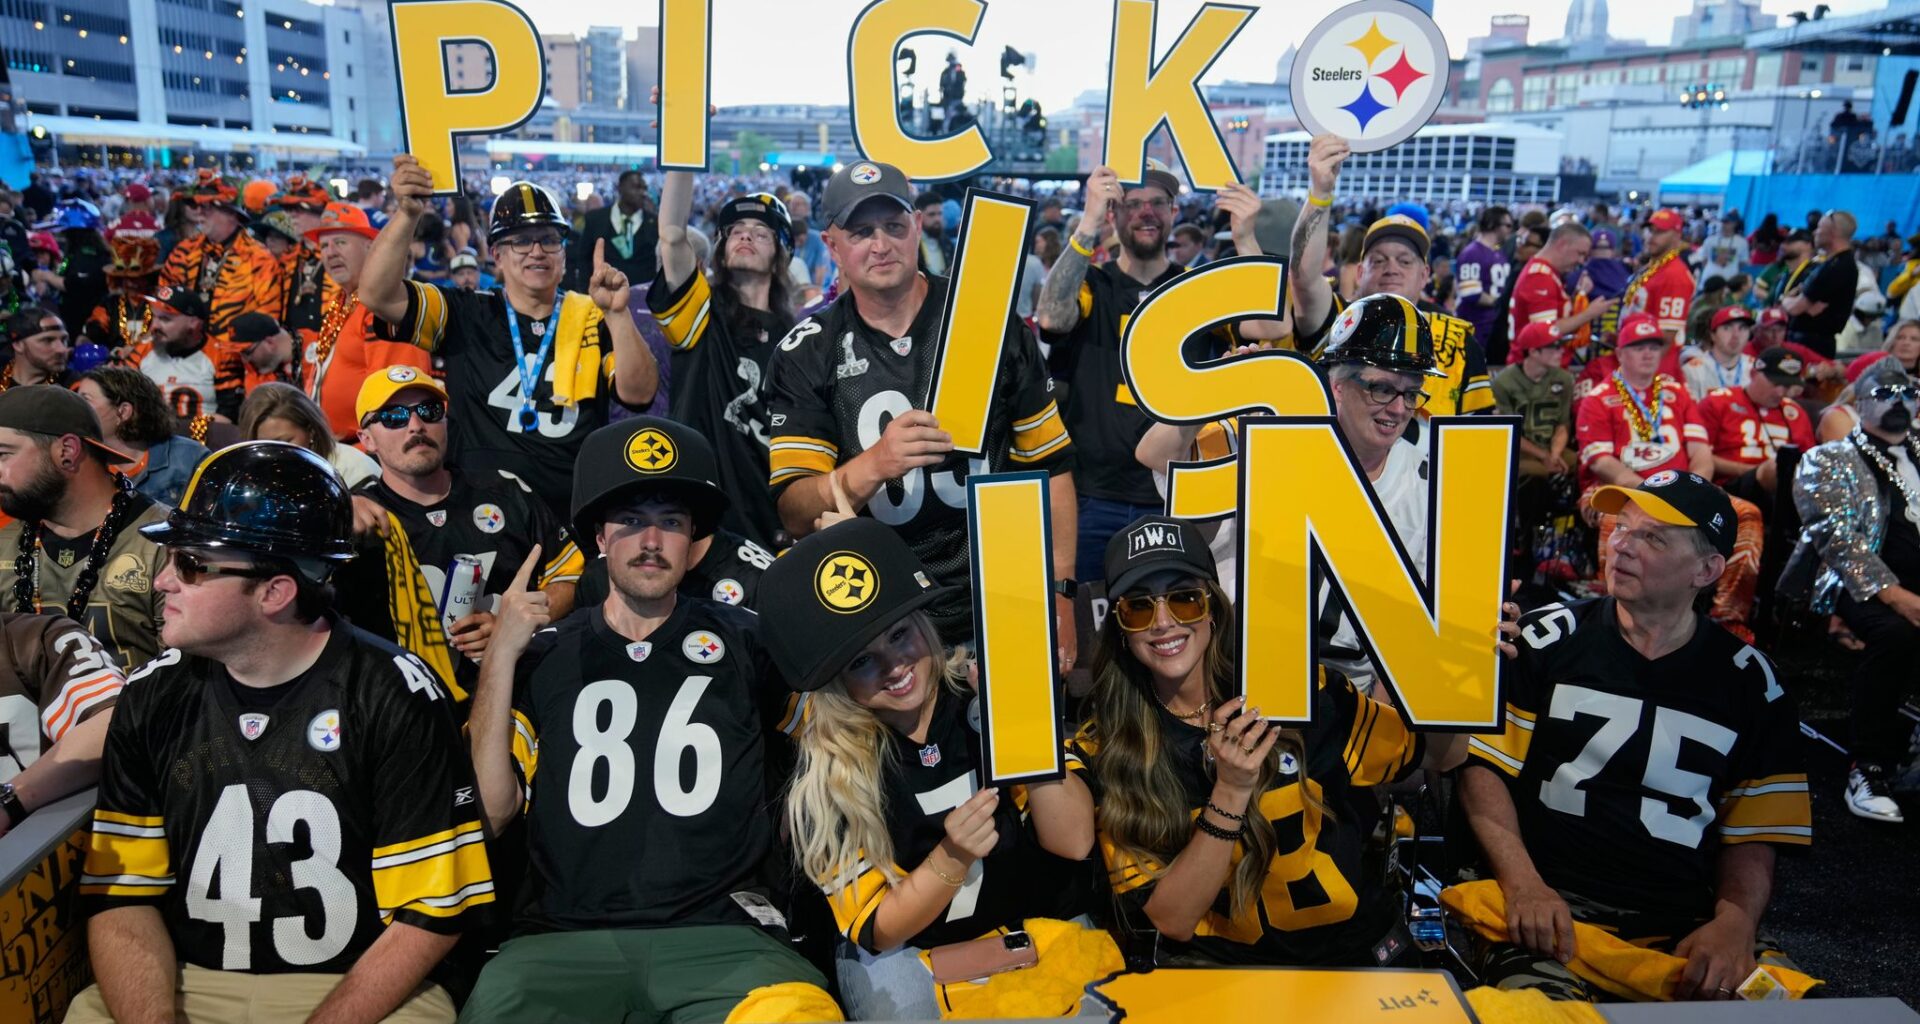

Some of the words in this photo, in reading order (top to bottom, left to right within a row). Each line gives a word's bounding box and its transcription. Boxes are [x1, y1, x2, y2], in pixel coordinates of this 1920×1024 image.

[1312, 67, 1362, 81] Steelers
[1460, 263, 1480, 280] 80
[1659, 297, 1684, 318] 58
[1135, 527, 1176, 550] nWo
[826, 581, 847, 596] Steelers
[568, 675, 722, 827] 86
[924, 753, 939, 764] NFL
[1538, 683, 1739, 849] 75
[186, 783, 358, 970] 43
[1378, 997, 1417, 1011] PIT
